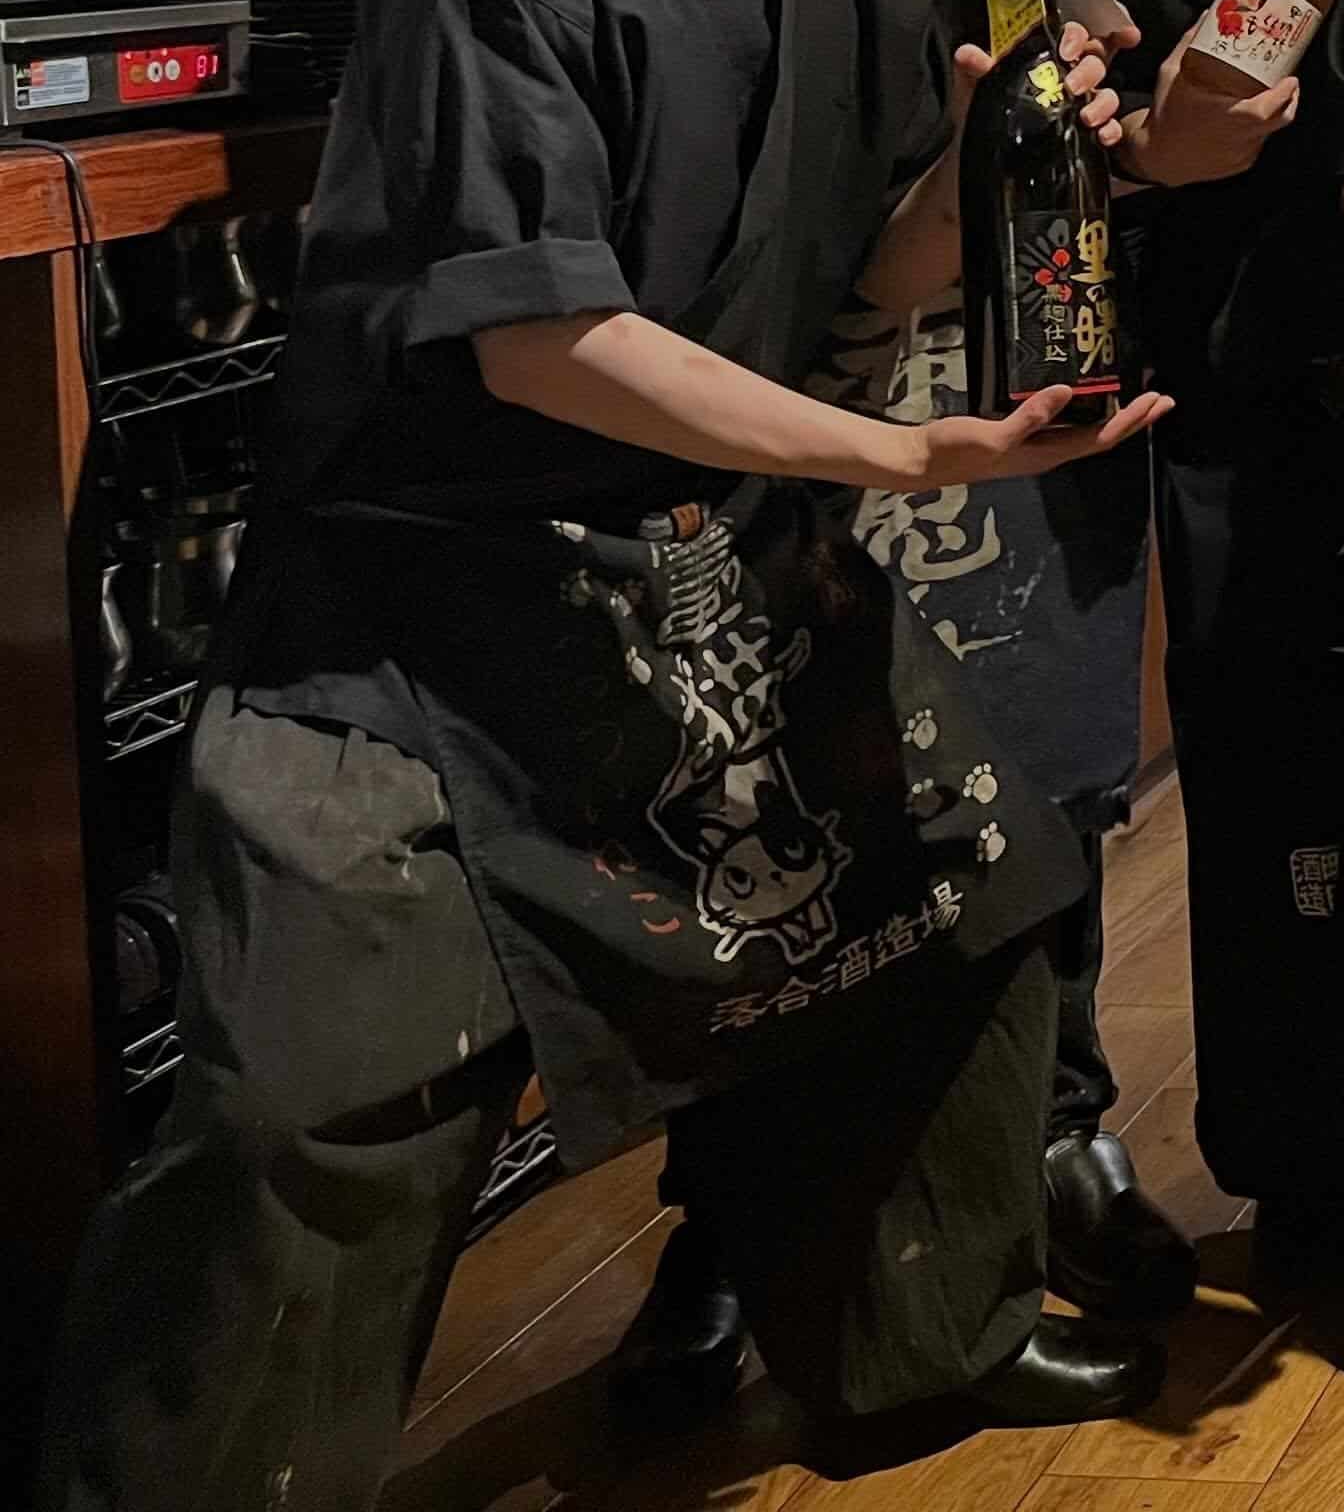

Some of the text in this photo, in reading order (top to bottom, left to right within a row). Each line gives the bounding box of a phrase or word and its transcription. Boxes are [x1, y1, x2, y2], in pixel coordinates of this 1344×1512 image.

[1069, 218, 1115, 375] 里の曙
[708, 878, 965, 1034] 落合酒造場
